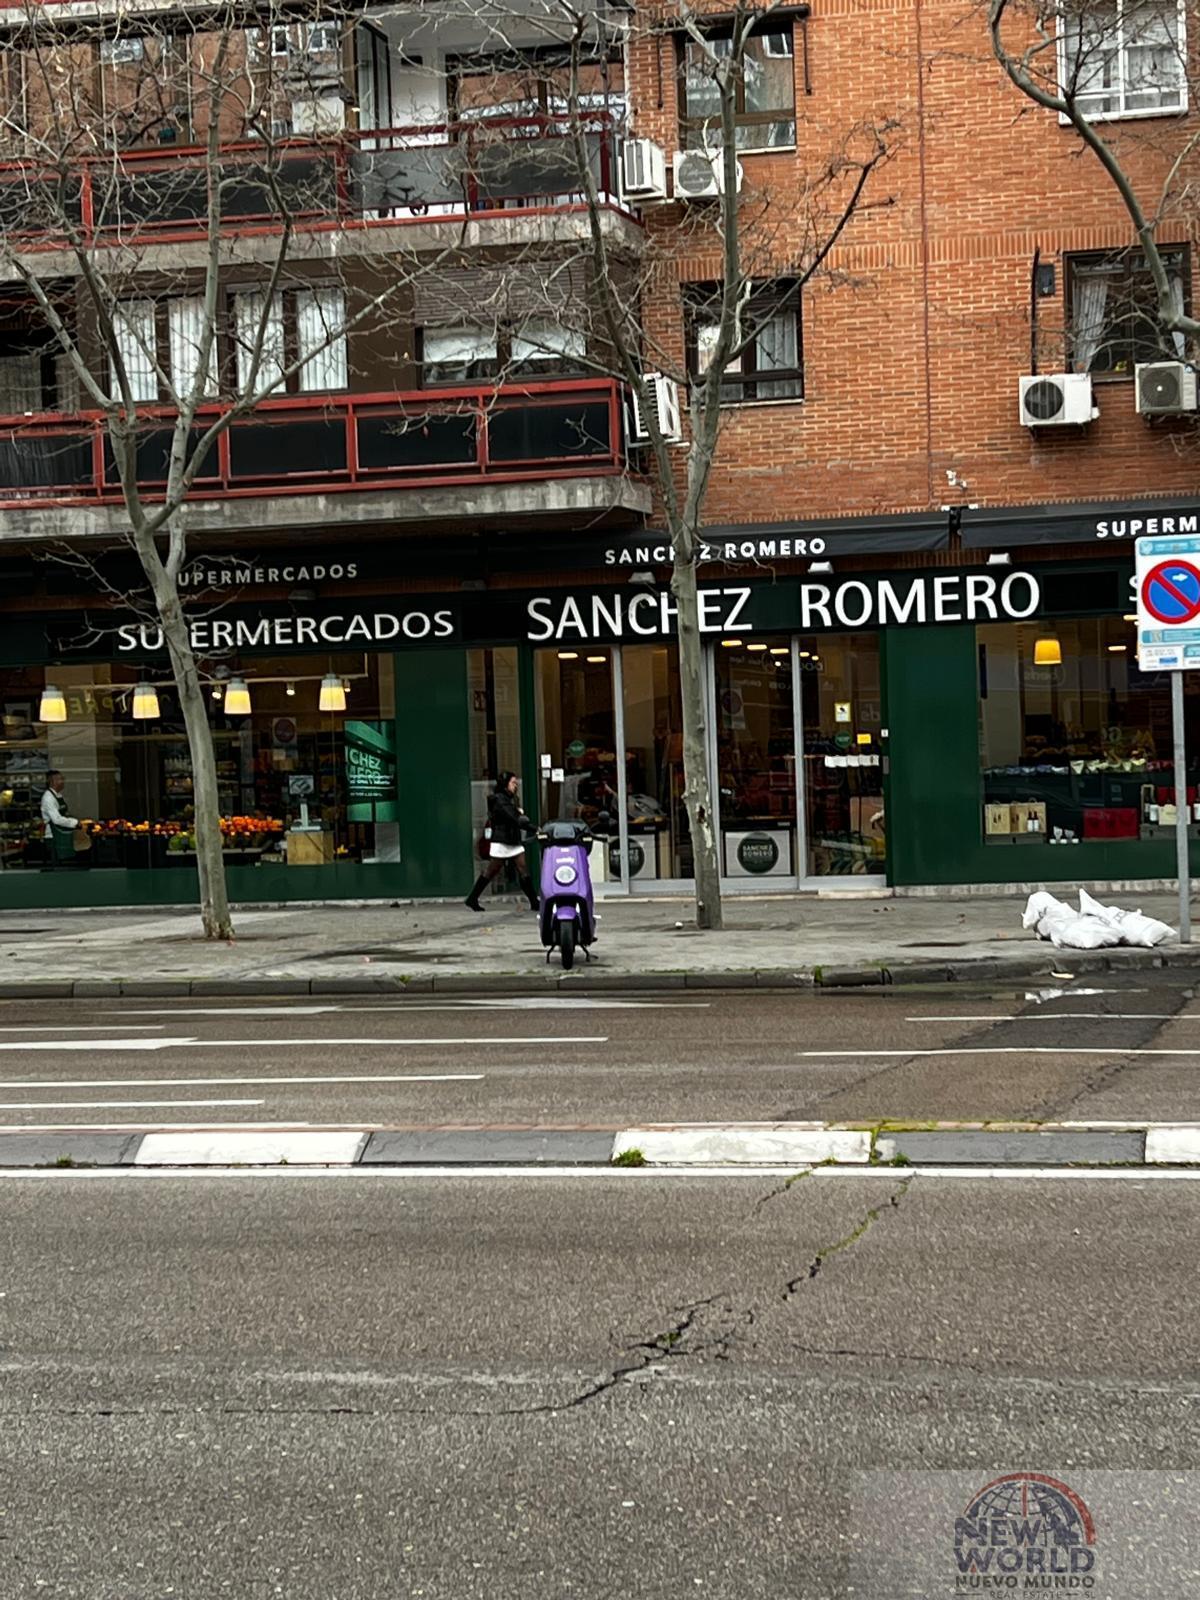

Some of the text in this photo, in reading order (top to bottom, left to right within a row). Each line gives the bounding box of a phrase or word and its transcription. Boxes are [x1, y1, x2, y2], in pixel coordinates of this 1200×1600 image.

[604, 537, 827, 565] SANCZ ROMERO
[177, 563, 359, 587] UPERMERCADOS
[799, 571, 1041, 629] ROMERO
[117, 610, 455, 652] SUERMERCADOS
